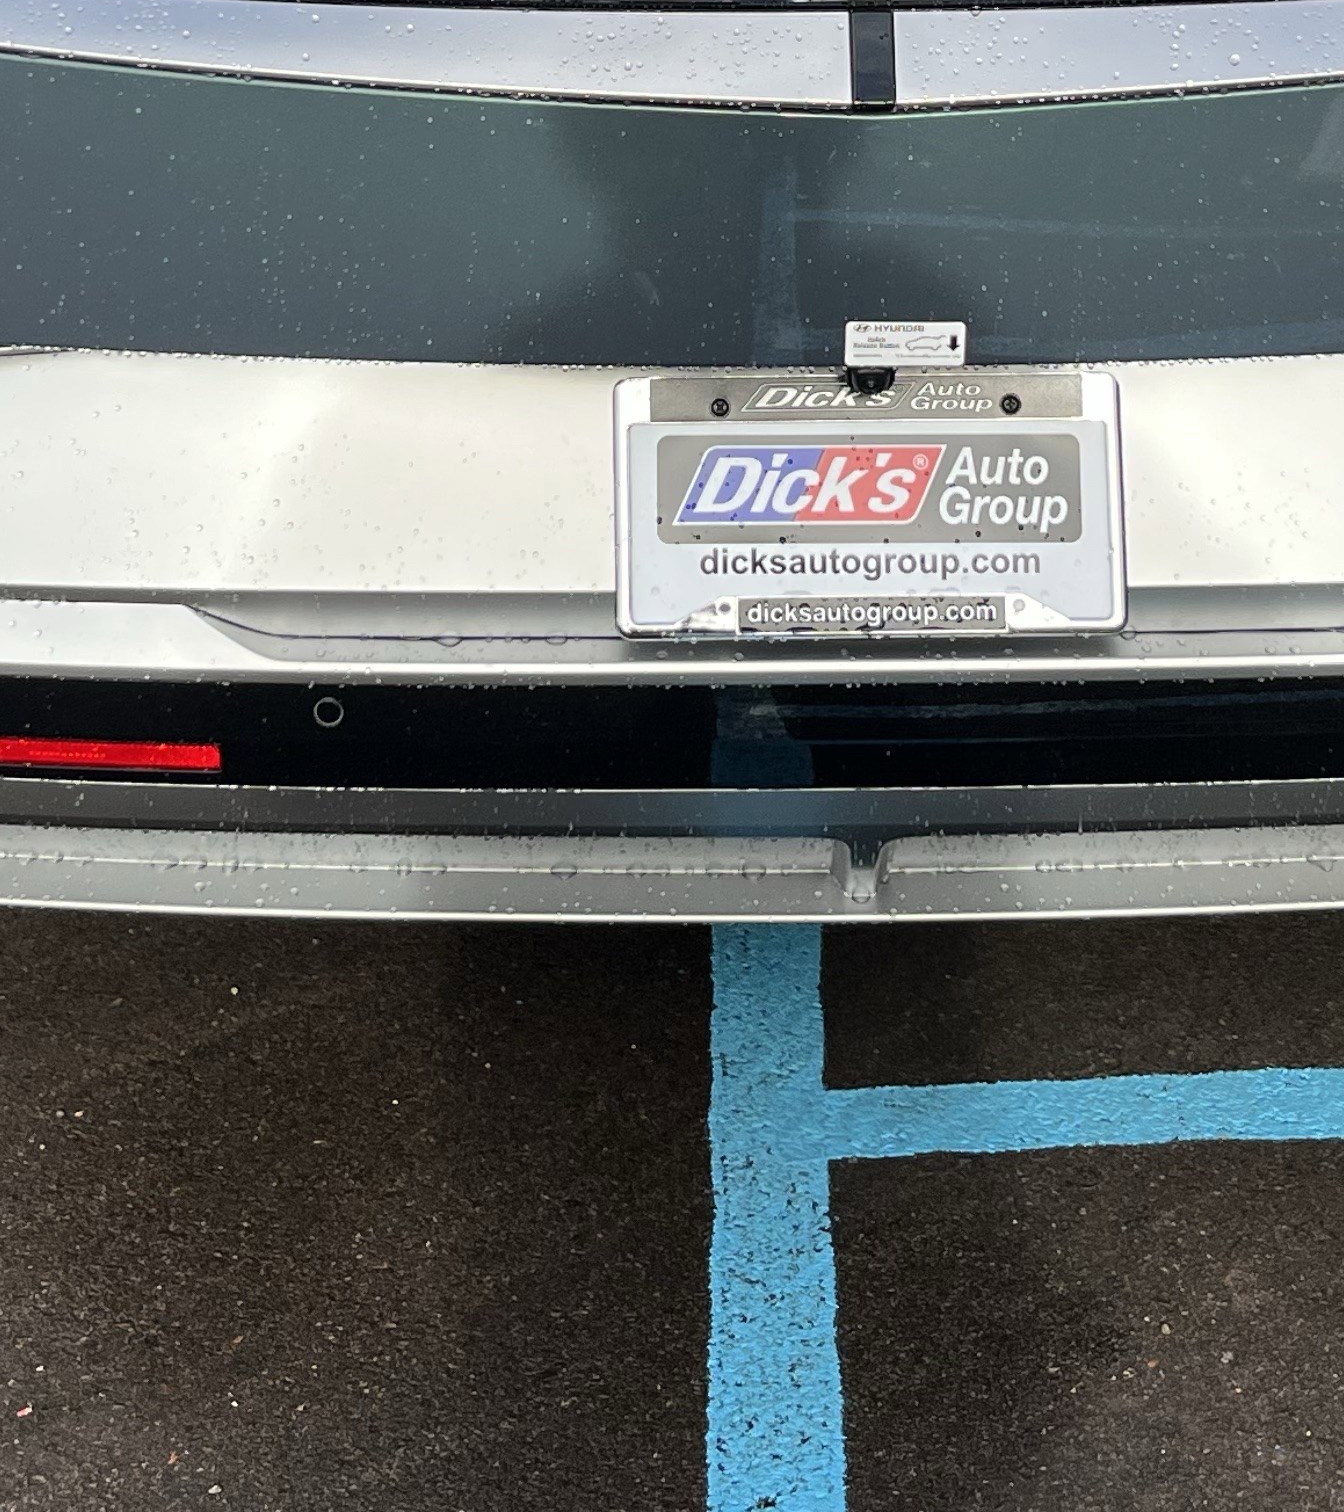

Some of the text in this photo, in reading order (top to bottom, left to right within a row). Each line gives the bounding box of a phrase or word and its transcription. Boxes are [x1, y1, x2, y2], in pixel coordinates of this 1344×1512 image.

[873, 324, 925, 333] HYUNDAI
[755, 382, 981, 408] Dicks Auto
[910, 395, 993, 411] Group
[944, 446, 1050, 486] Auto
[938, 485, 1069, 533] Group
[699, 547, 1041, 581] dicksautogroup.com
[747, 600, 998, 627] dicksautogroup.com
